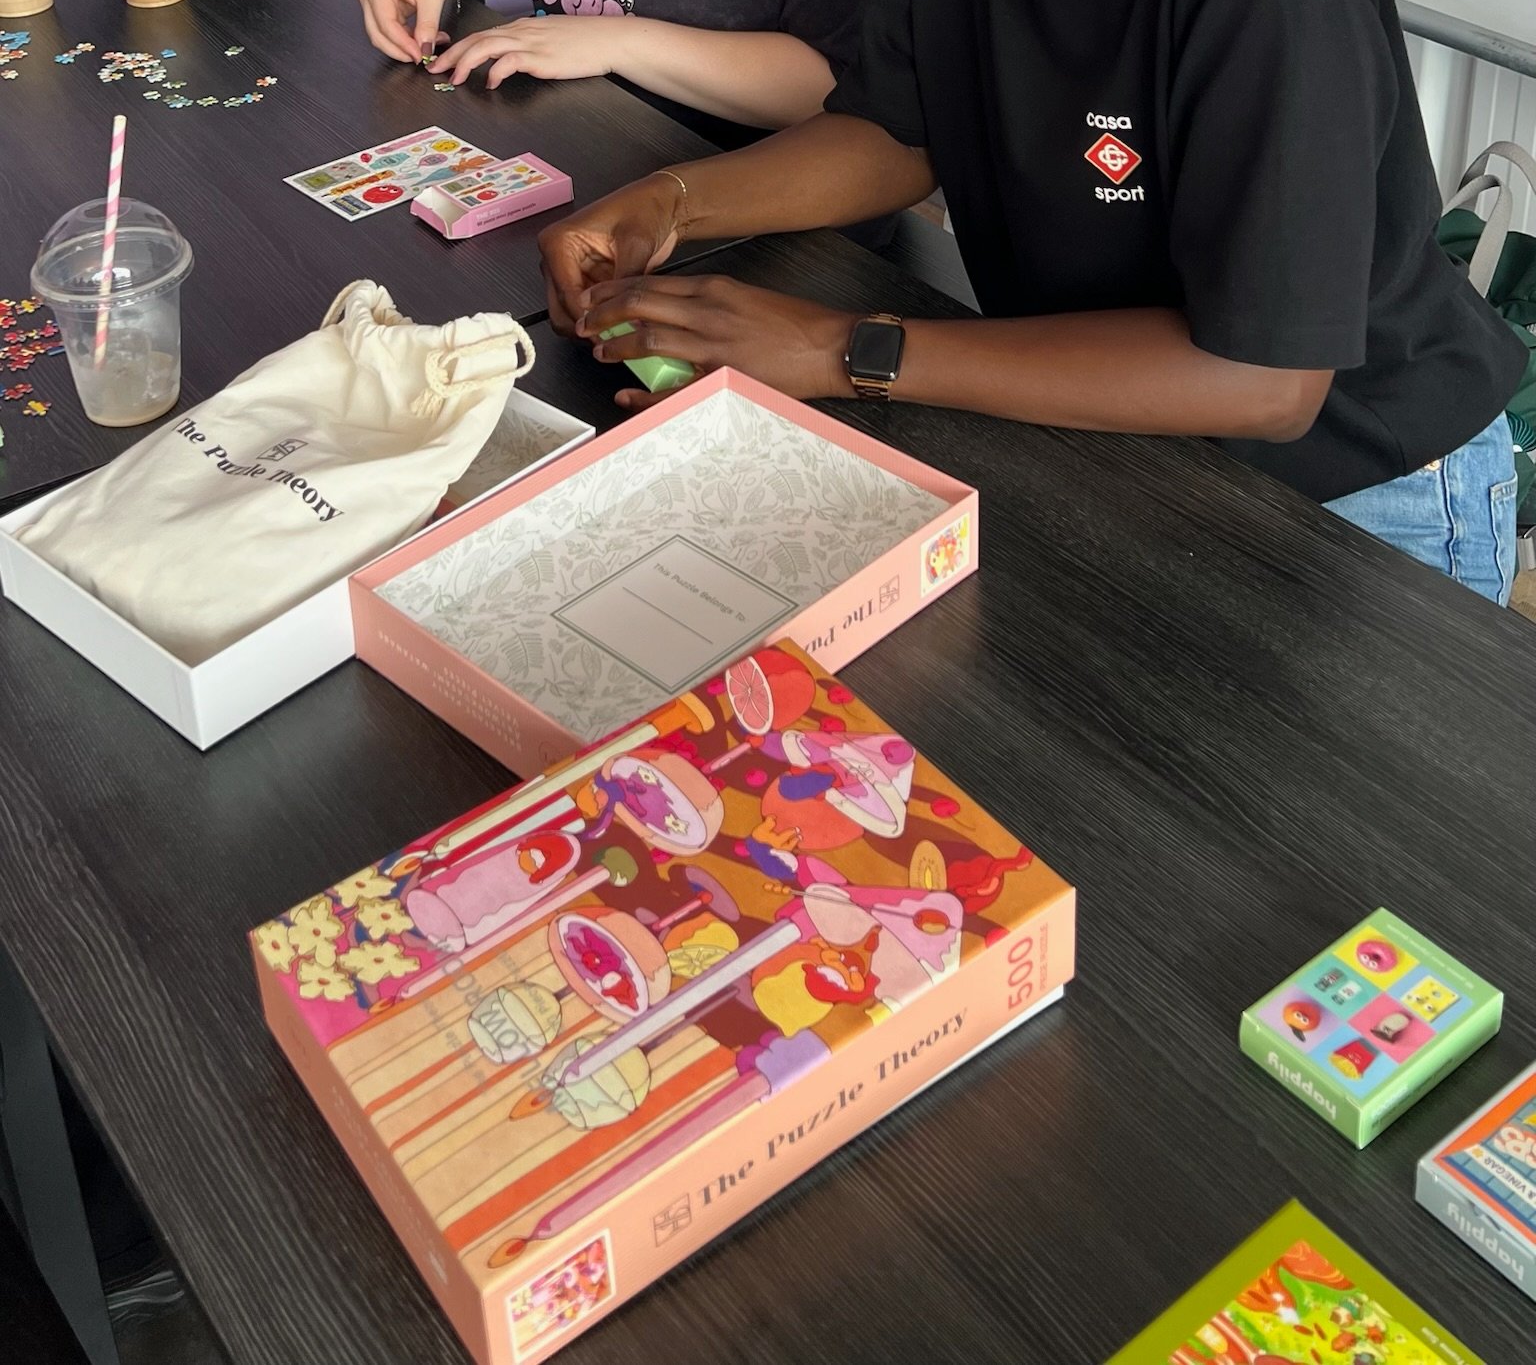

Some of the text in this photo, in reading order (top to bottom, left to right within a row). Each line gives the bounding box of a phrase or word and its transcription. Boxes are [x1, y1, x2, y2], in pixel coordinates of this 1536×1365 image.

[1086, 112, 1133, 130] casa
[1095, 185, 1145, 203] sport
[172, 417, 345, 522] The Puzzle Theory
[653, 562, 671, 577] This
[671, 573, 700, 594] Puzzle
[699, 591, 734, 615] Belongs
[842, 599, 876, 629] The
[1008, 936, 1034, 1010] 500
[697, 1007, 969, 1208] The Puzzle Theory
[1267, 1051, 1337, 1120] happily
[1484, 1157, 1526, 1192] VINEGAR
[1447, 1201, 1525, 1281] happily
